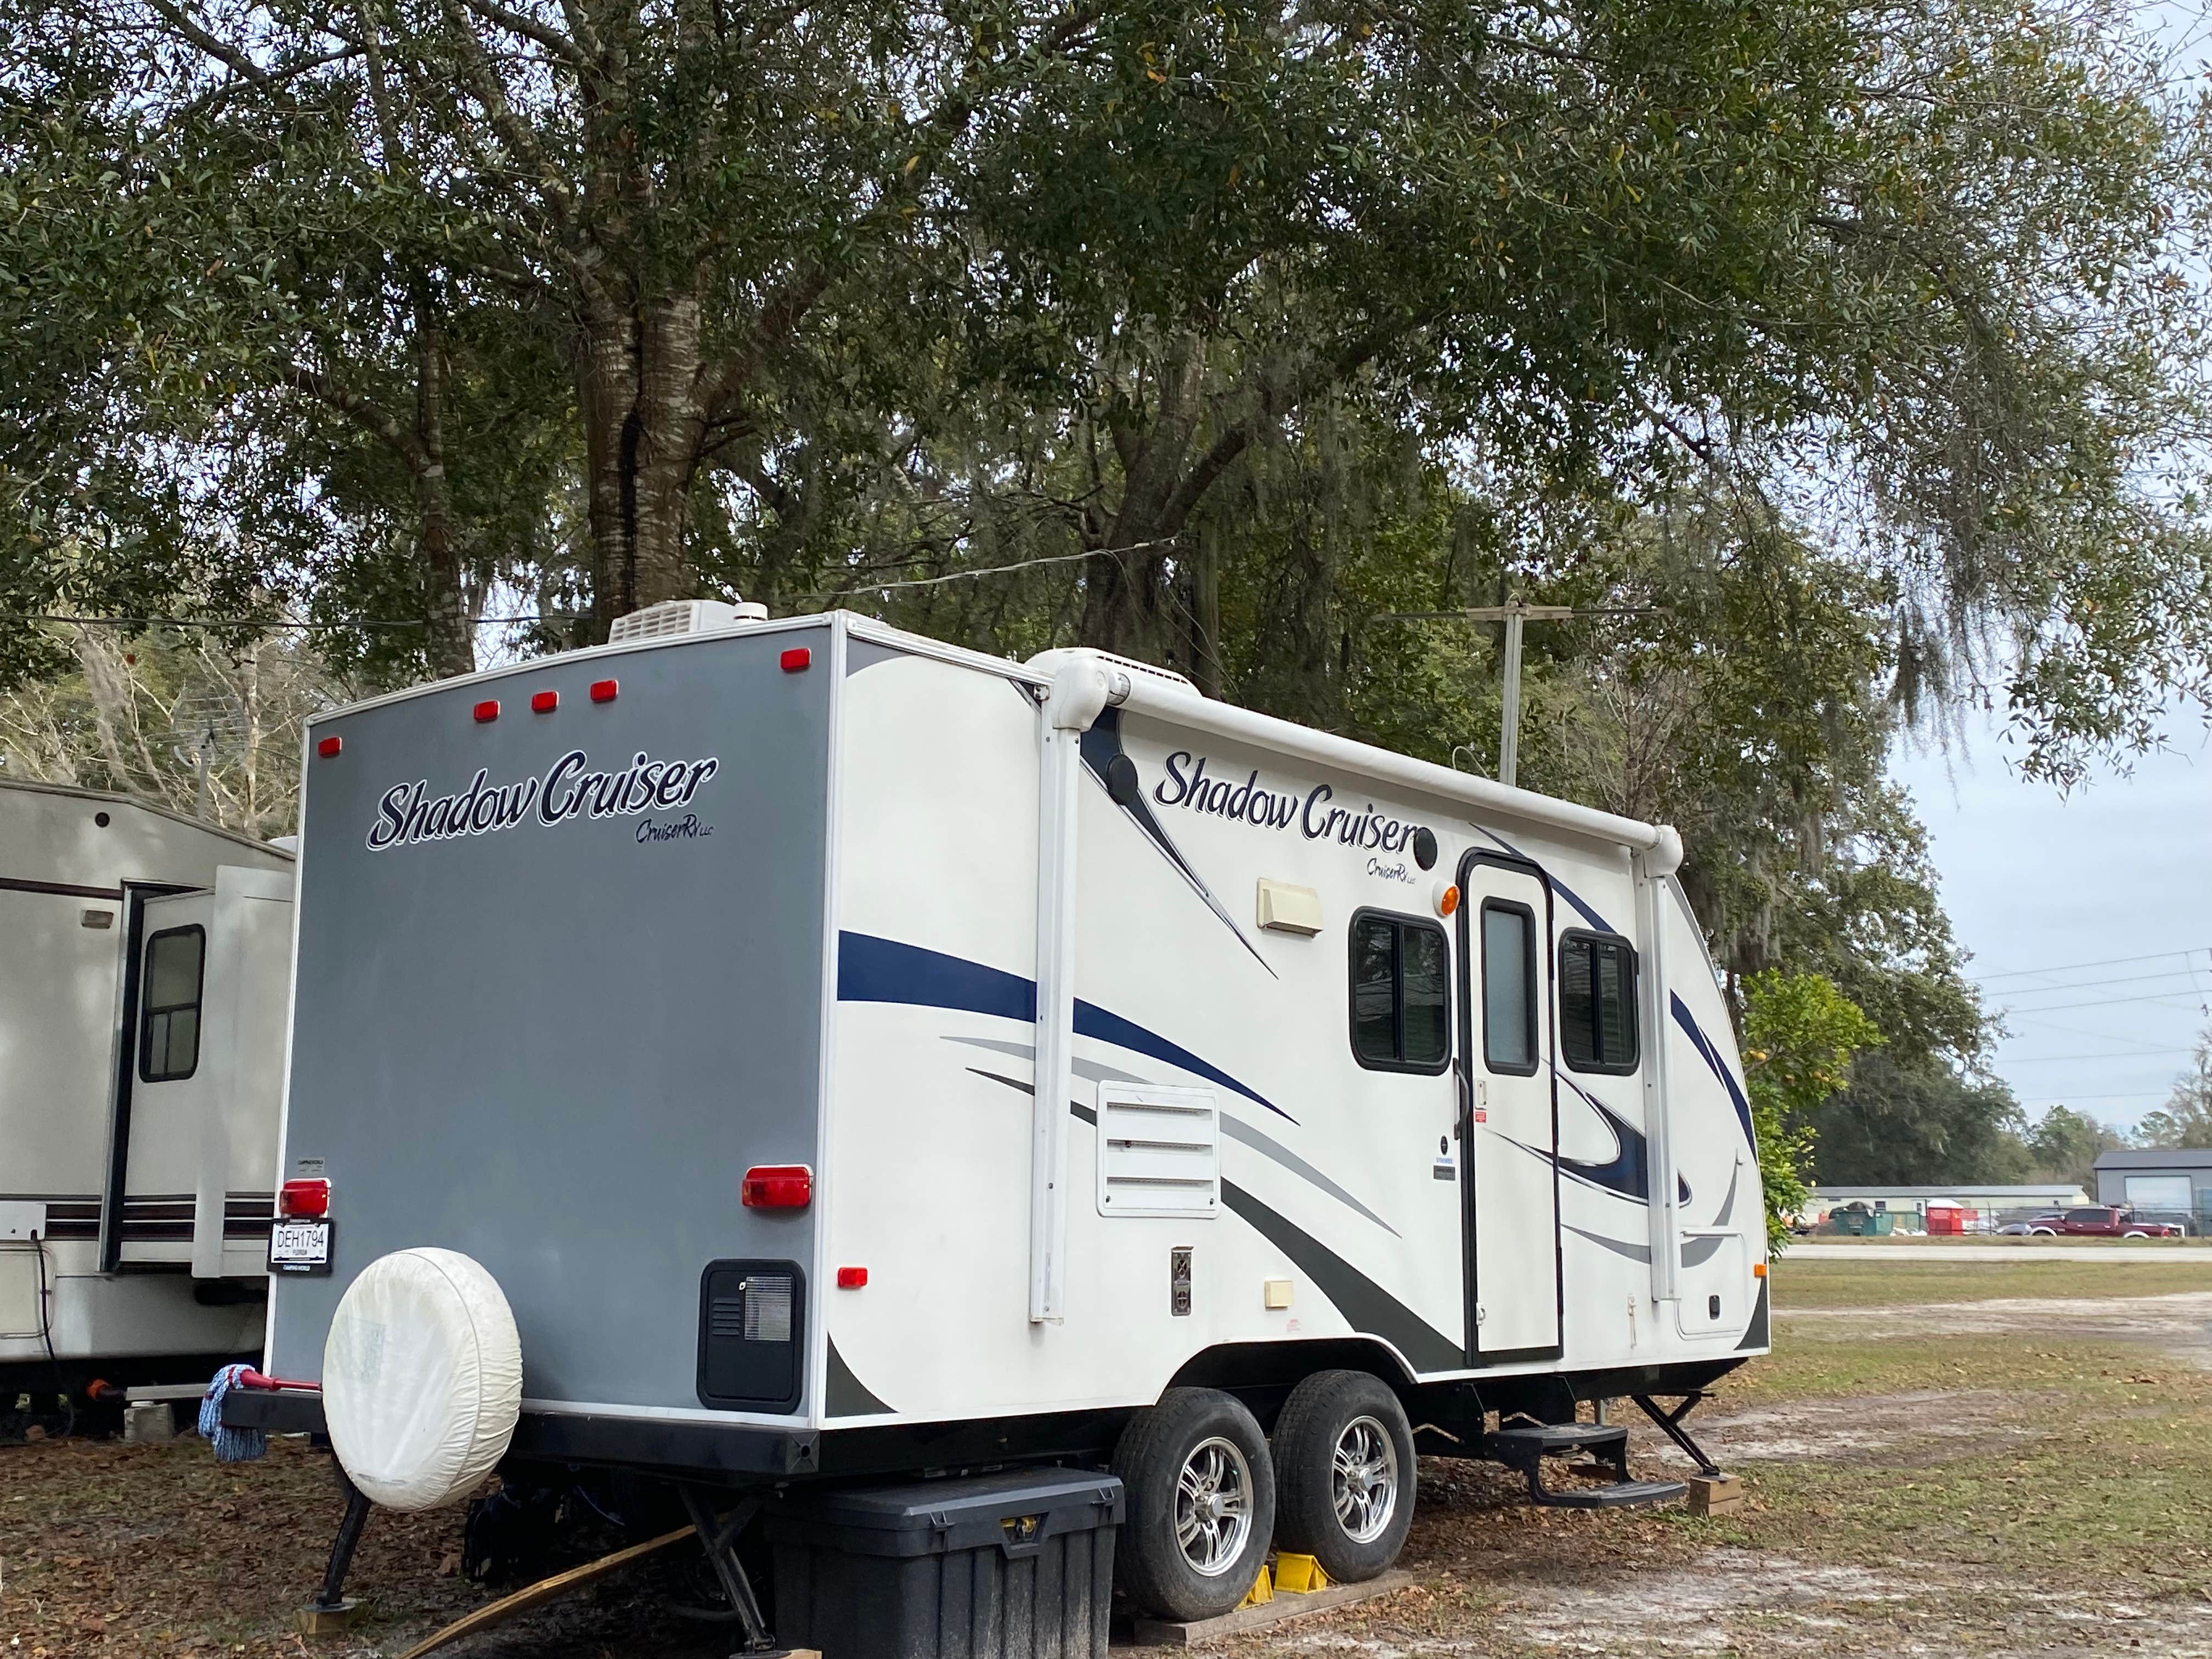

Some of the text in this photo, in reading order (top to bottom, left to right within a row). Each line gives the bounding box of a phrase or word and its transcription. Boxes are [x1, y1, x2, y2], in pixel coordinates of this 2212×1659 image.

[366, 750, 719, 851] Shadow Cruiser
[1154, 751, 1419, 854] Shadow Cruiser
[278, 1230, 324, 1248] DEH1794
